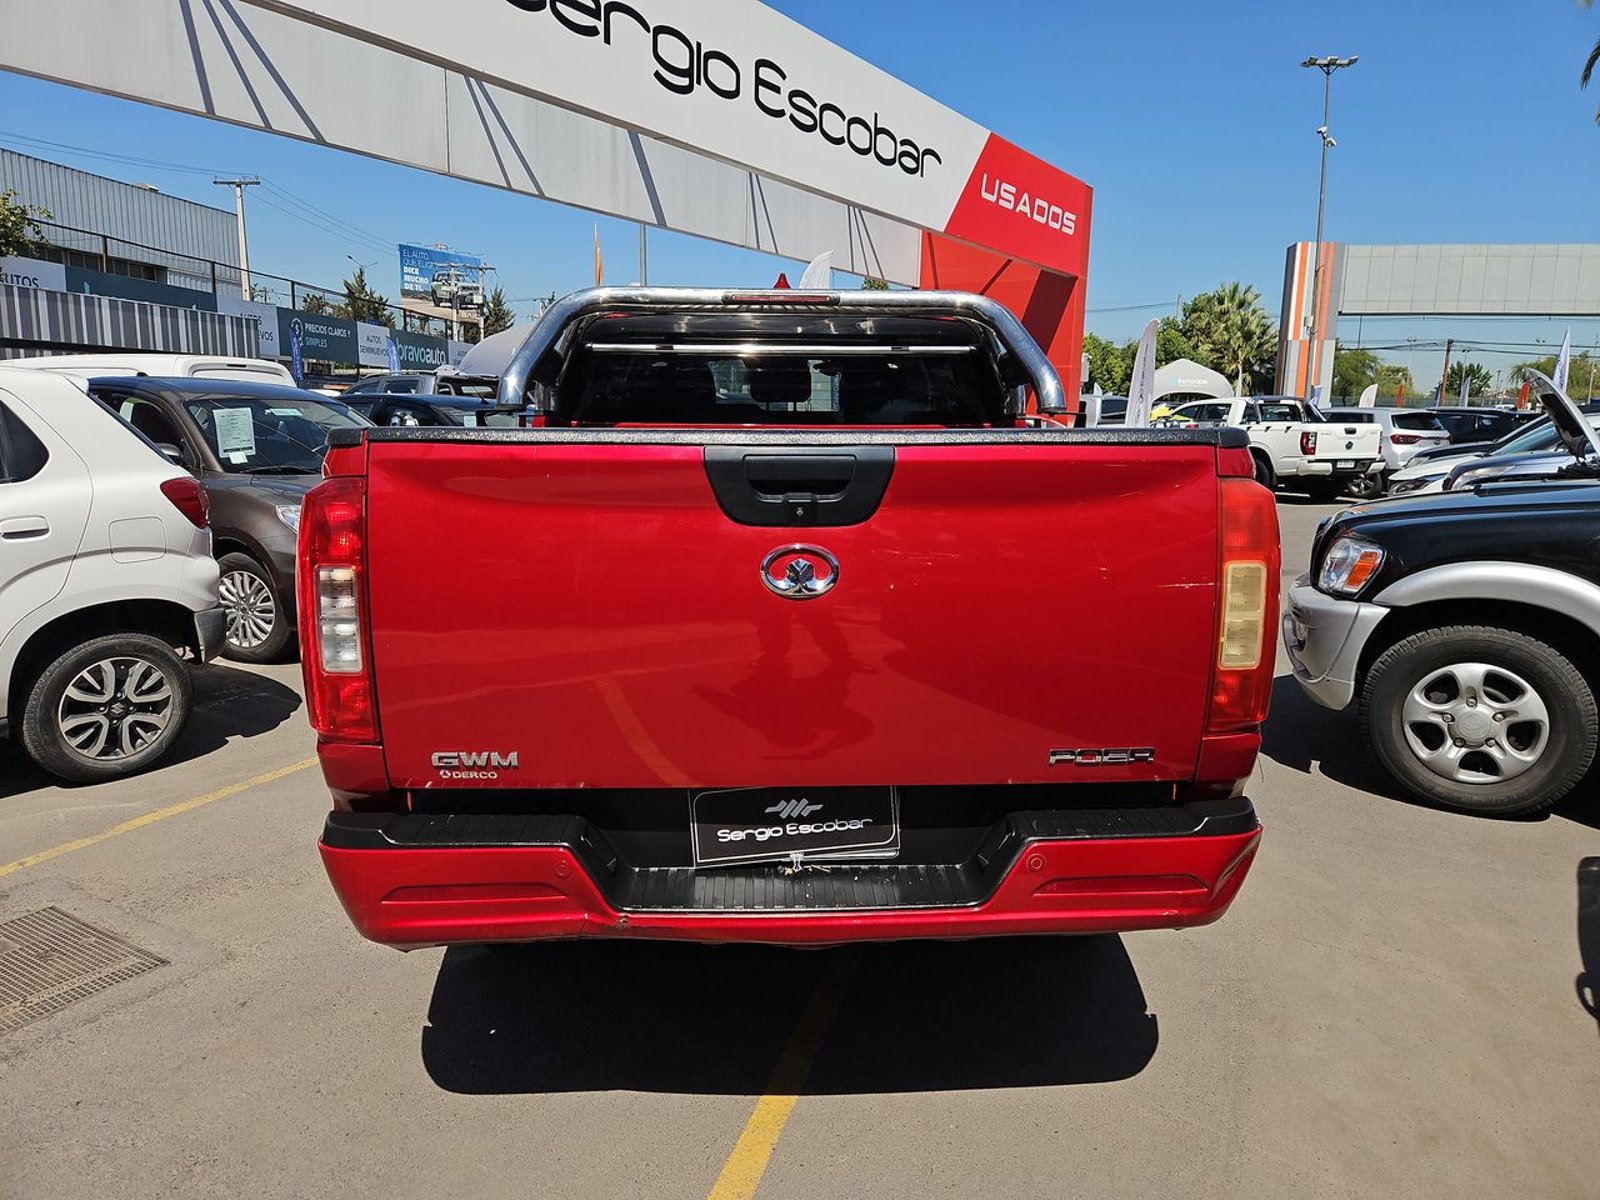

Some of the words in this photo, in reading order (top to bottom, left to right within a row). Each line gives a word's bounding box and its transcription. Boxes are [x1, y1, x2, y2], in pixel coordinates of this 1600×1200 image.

[506, 0, 740, 100] ergio
[754, 58, 942, 178] Escobar
[981, 173, 1077, 235] USADOS
[403, 266, 420, 275] DICE
[403, 274, 429, 284] MUCHO
[404, 283, 415, 291] DE
[304, 323, 327, 335] PRECIOS
[328, 326, 347, 338] CLAROS
[305, 336, 328, 348] SIMPLES
[366, 334, 382, 345] AUTOS
[396, 337, 447, 365] bravoauto
[431, 751, 518, 767] GWM
[1048, 747, 1155, 766] POER
[452, 770, 498, 779] DERCO
[716, 827, 784, 842] Sergio
[785, 818, 873, 836] Escobar
